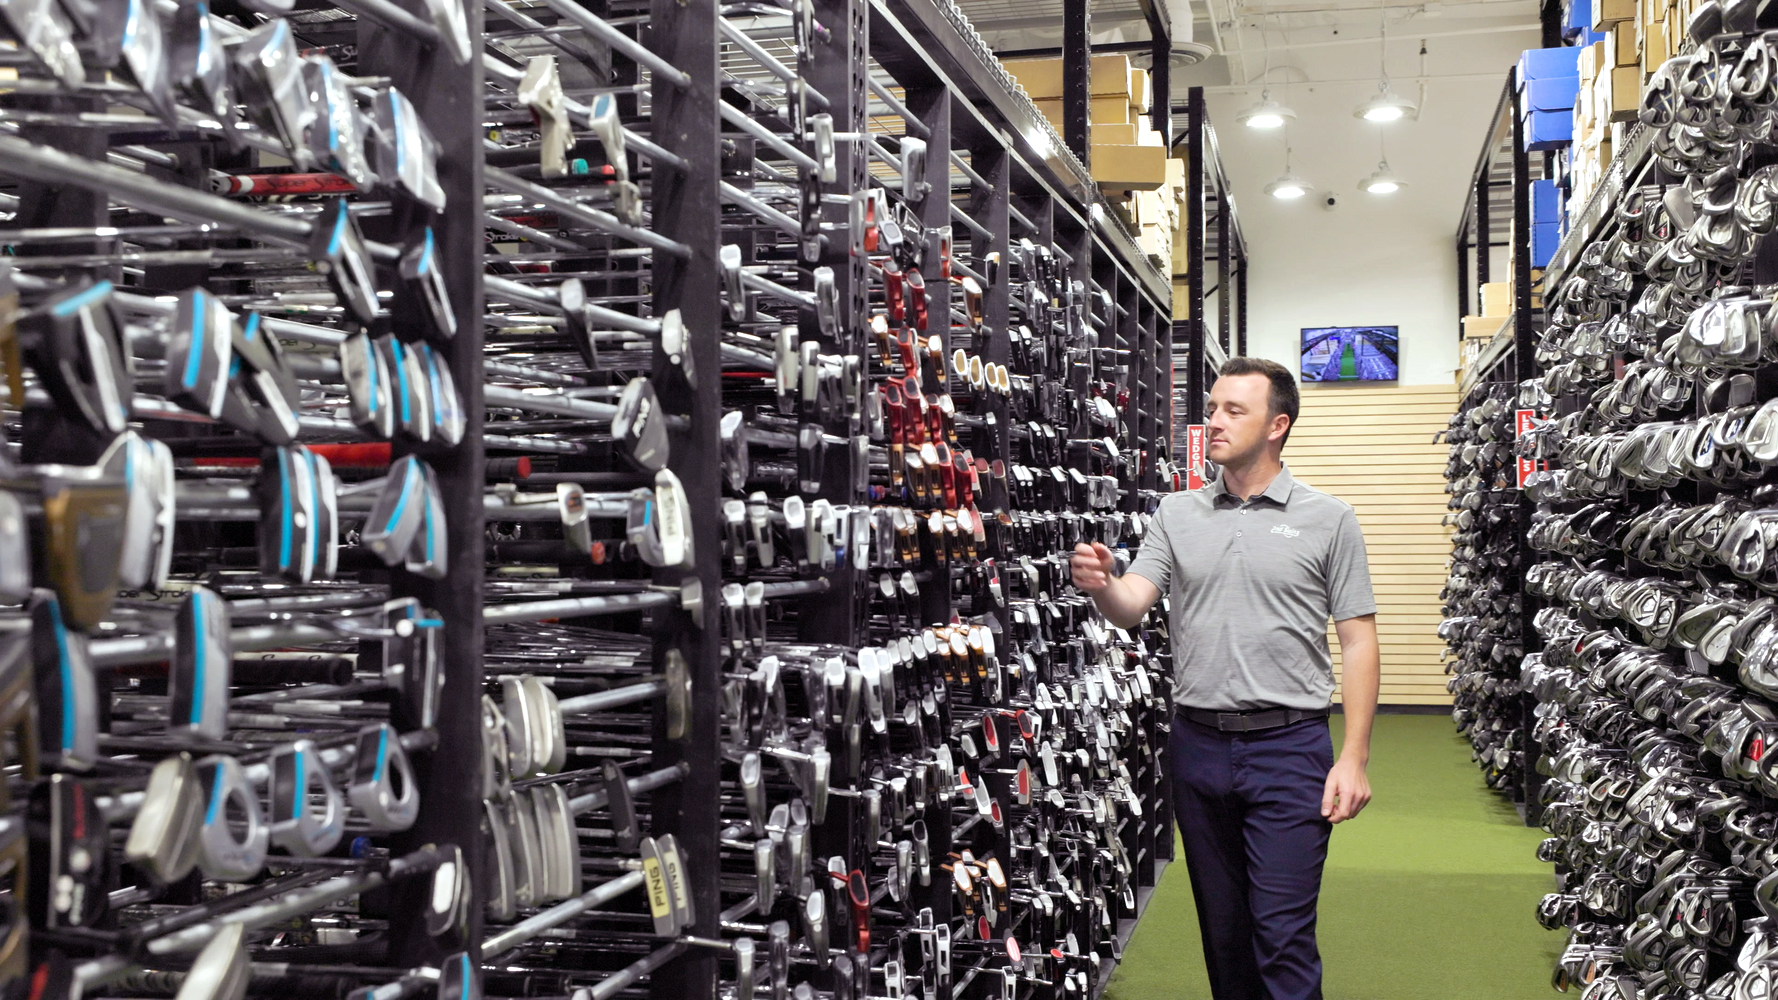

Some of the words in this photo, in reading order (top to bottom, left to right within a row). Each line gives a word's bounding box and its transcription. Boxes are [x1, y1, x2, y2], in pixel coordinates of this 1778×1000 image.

[146, 586, 189, 602] Strok
[649, 866, 666, 907] PING
[668, 862, 682, 902] ING
